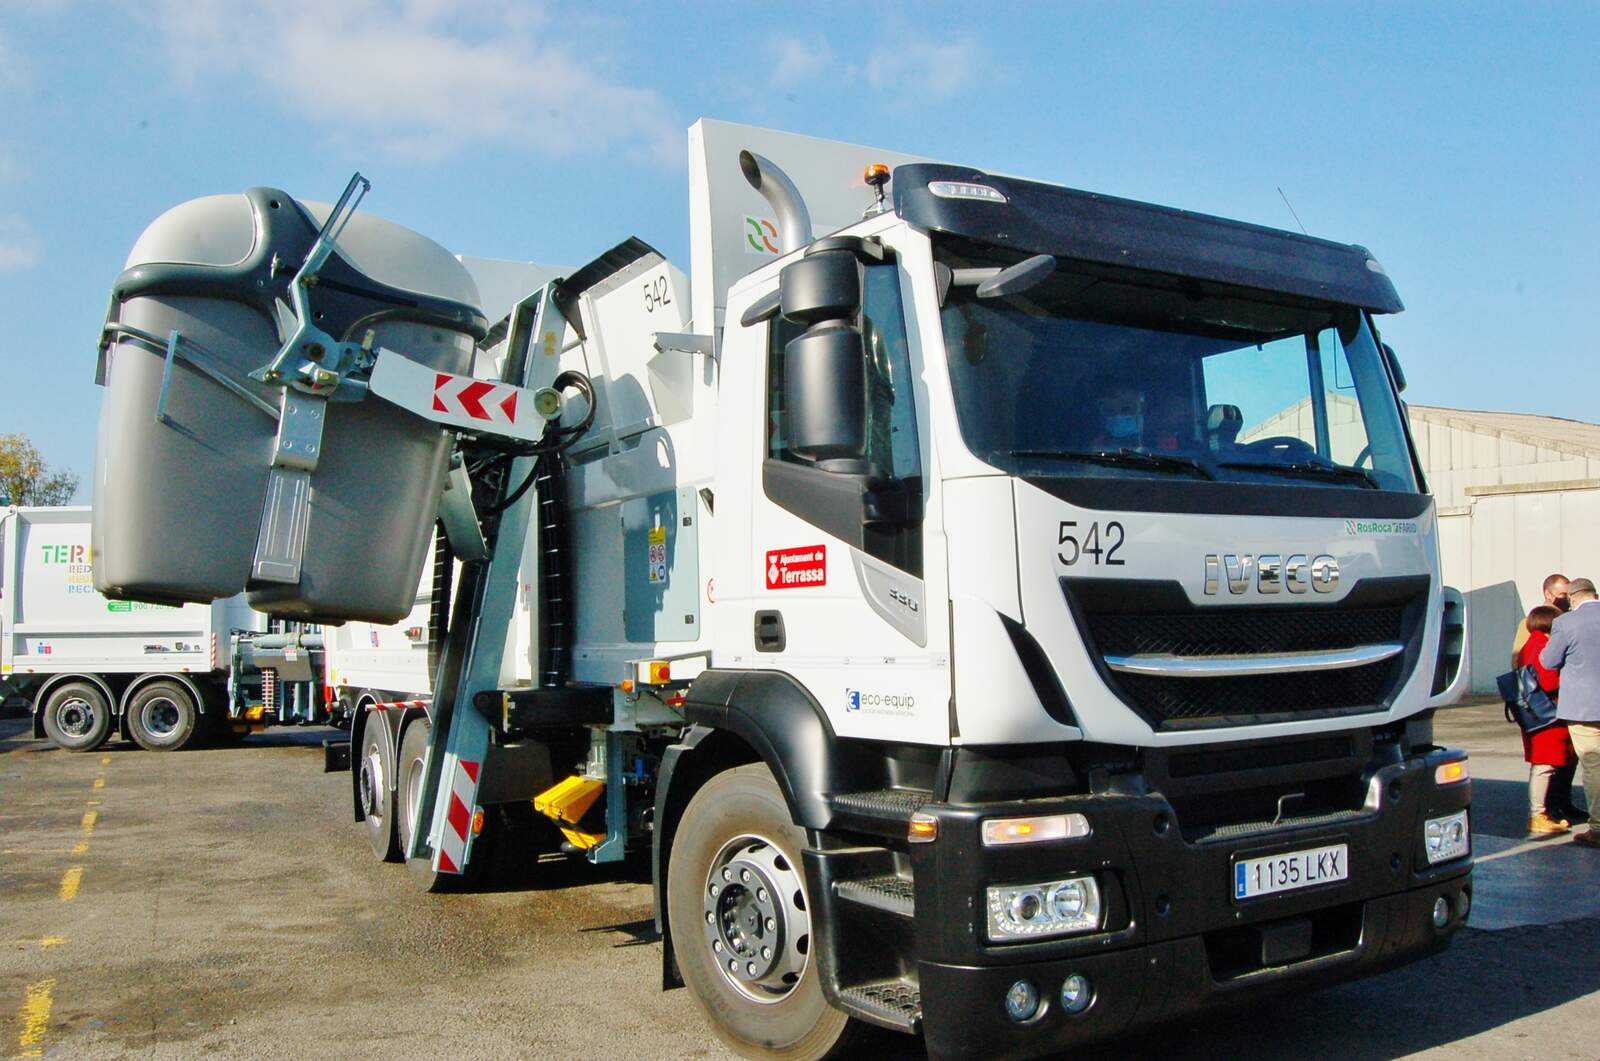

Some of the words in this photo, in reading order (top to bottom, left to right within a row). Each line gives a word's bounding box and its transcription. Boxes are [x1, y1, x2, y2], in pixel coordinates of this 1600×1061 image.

[643, 275, 671, 312] 542
[1357, 522, 1393, 533] RosRoca
[1057, 521, 1126, 566] 542
[780, 552, 814, 566] Ajuntament
[815, 550, 824, 561] de
[780, 567, 824, 583] Terrassa
[1203, 554, 1340, 595] IVECO
[861, 692, 915, 710] eco-equip
[1255, 859, 1300, 889] 1135
[1306, 850, 1340, 880] LKX
